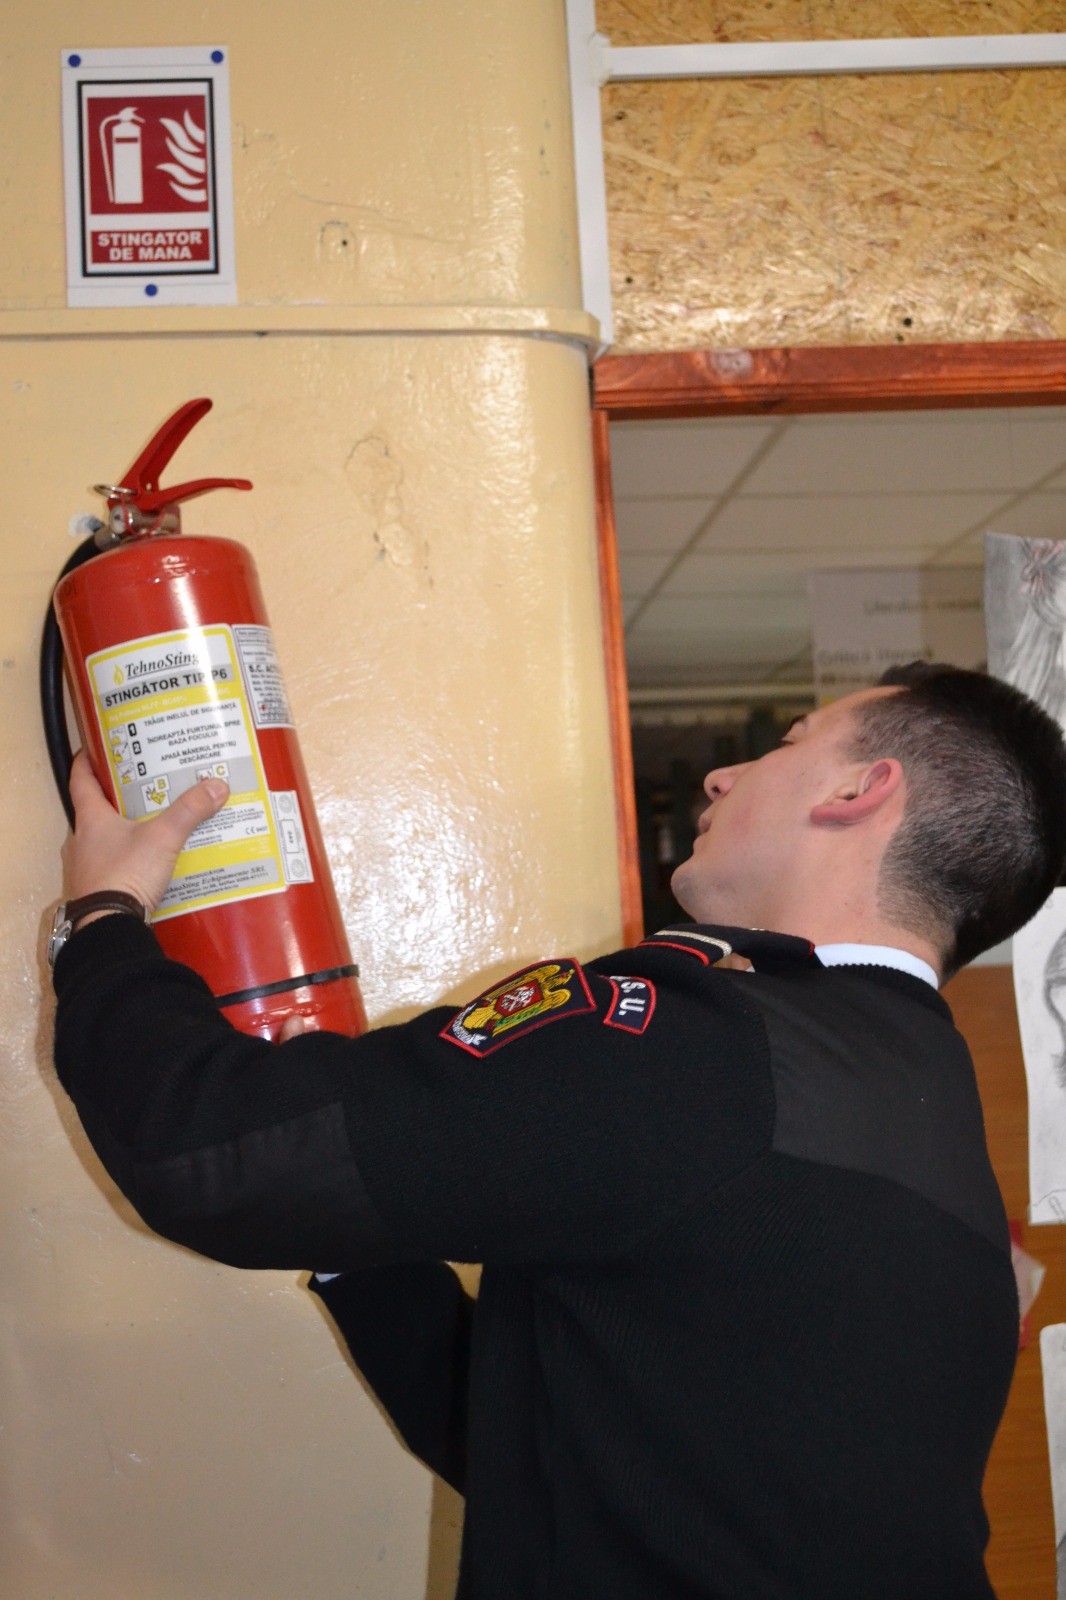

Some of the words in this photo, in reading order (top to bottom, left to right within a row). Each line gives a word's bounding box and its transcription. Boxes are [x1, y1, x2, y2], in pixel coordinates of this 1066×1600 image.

[98, 231, 203, 247] STINGATOR
[109, 247, 134, 261] DE
[138, 245, 192, 260] MANA
[125, 651, 200, 677] TehnoSting
[183, 672, 205, 686] TIP
[212, 668, 228, 681] P6
[105, 677, 180, 707] STINGĂTOR
[190, 708, 199, 717] DE
